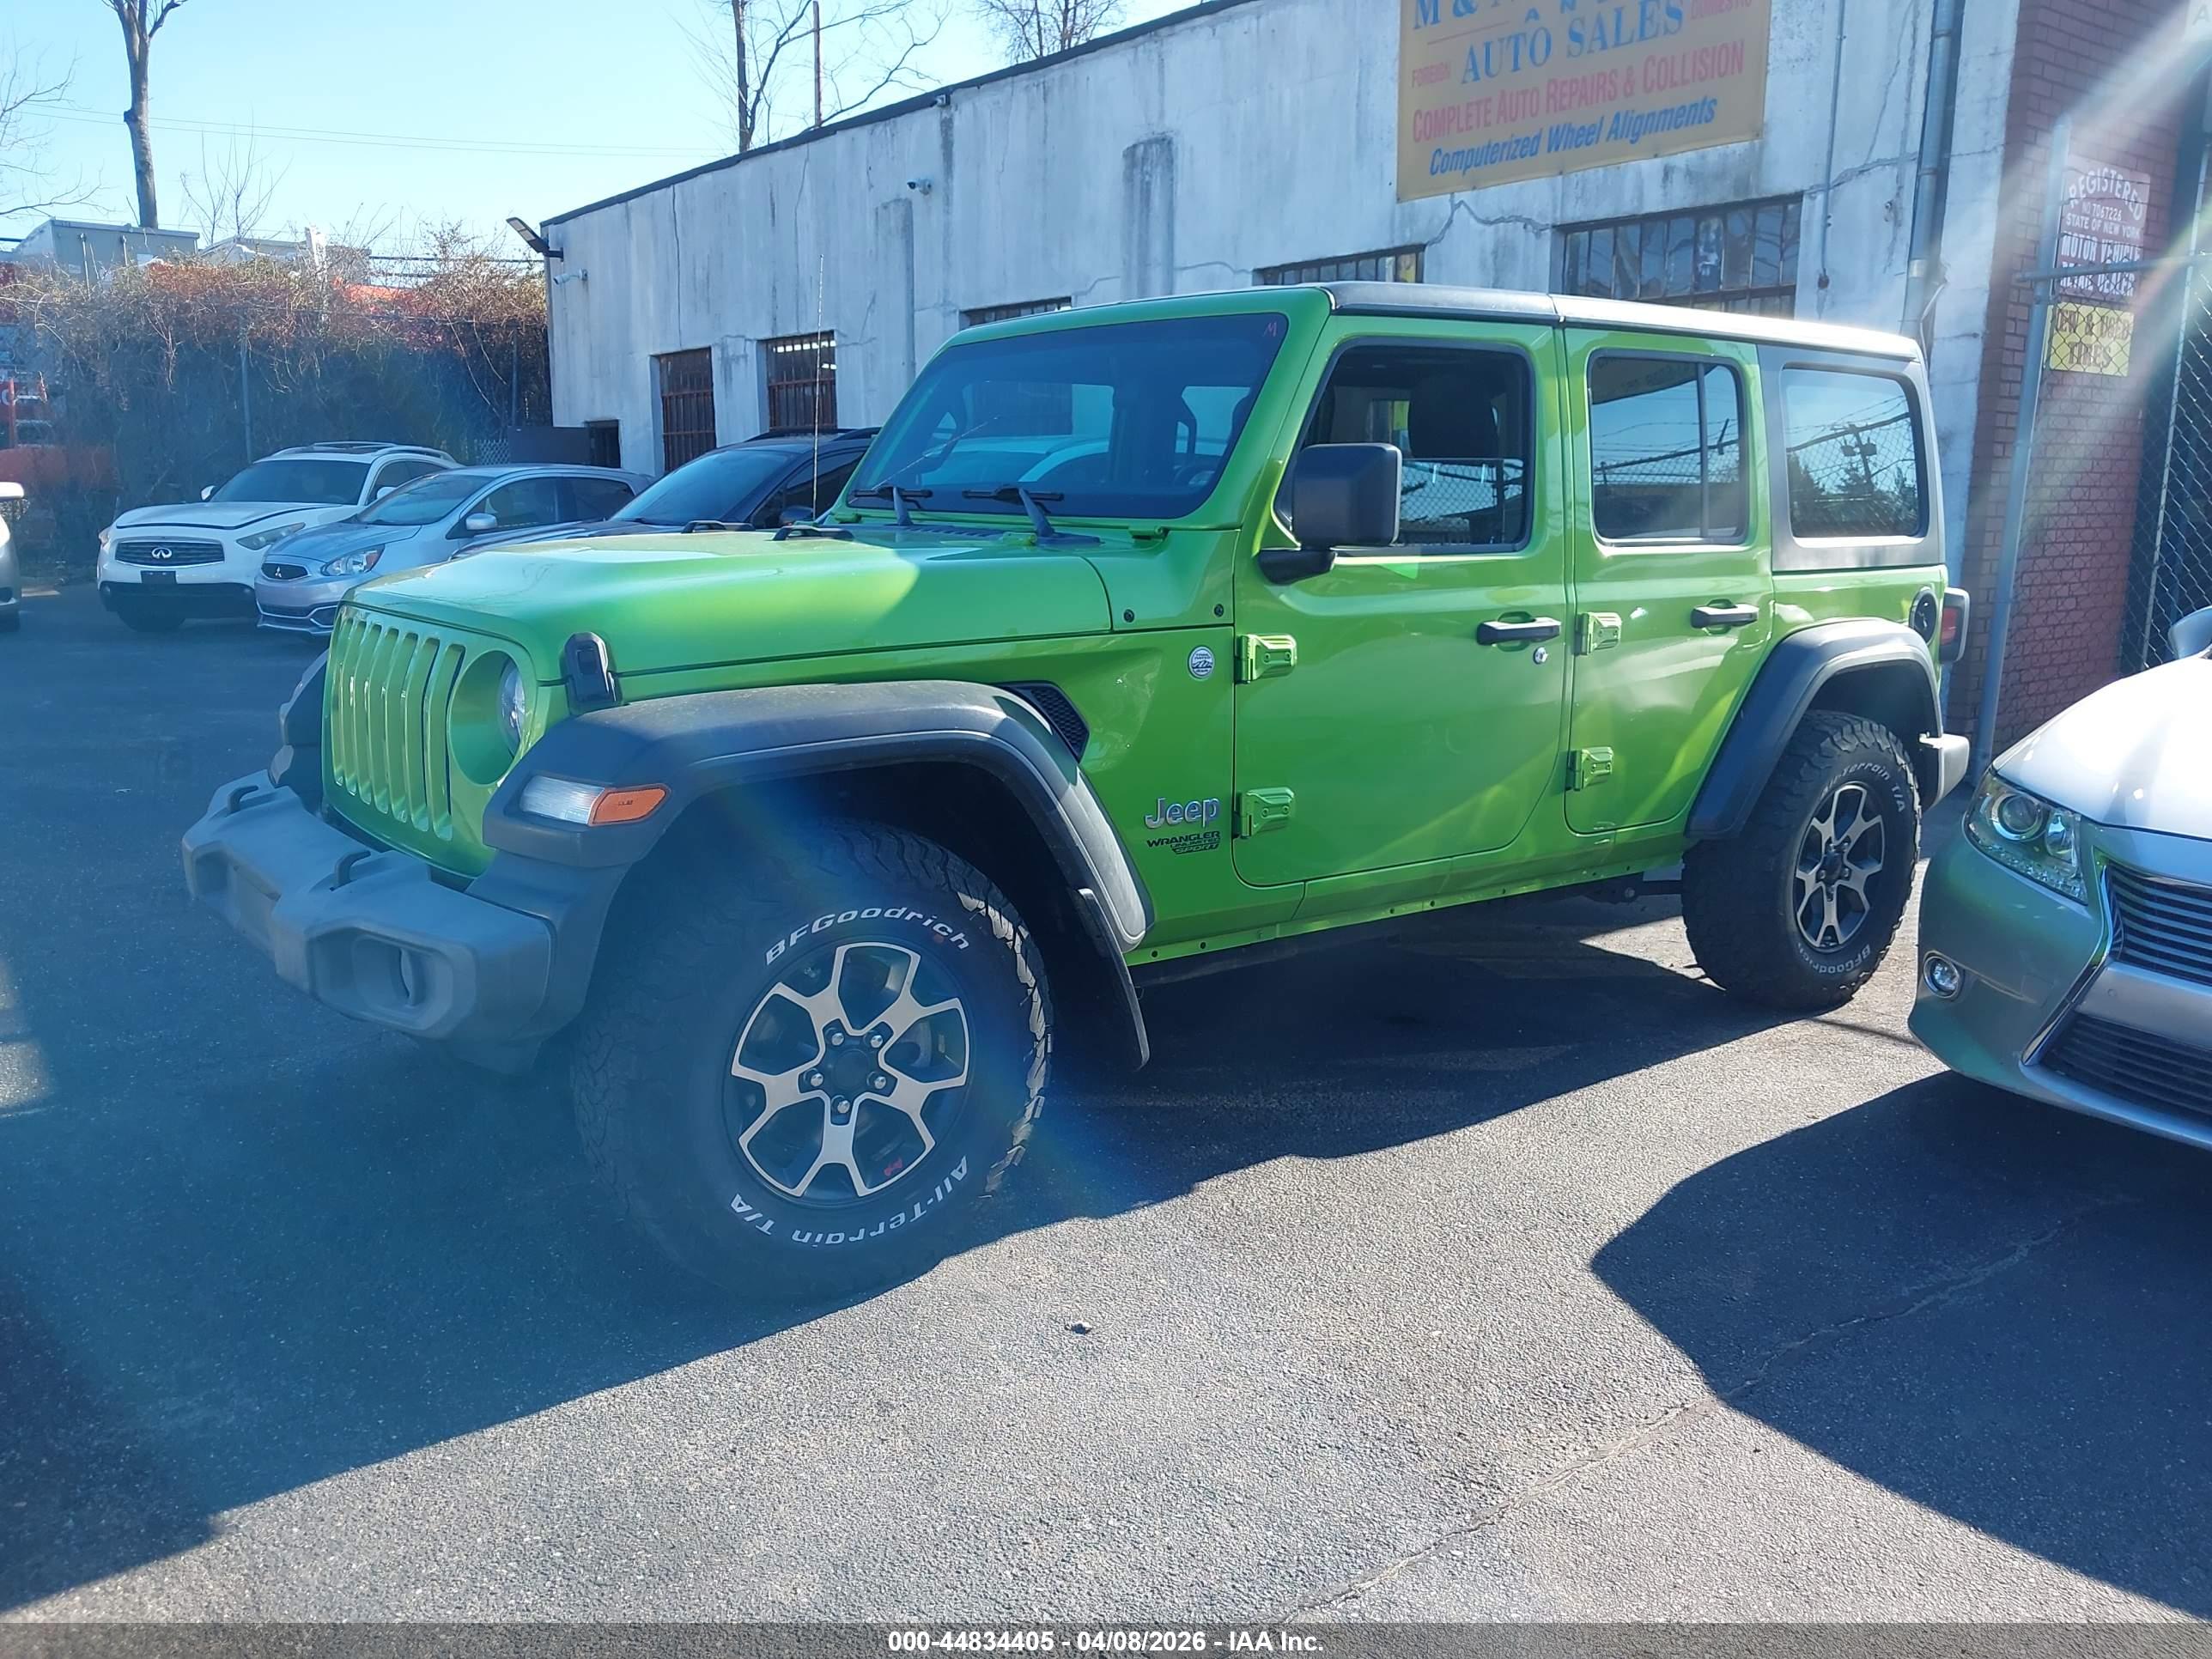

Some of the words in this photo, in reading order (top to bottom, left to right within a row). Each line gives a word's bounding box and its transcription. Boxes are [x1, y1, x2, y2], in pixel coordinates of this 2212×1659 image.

[1461, 31, 1552, 84] AUTO
[1566, 0, 1684, 58] SALES
[1413, 96, 1492, 143] COMPLETE
[1496, 88, 1540, 125] AUTO
[1546, 68, 1619, 113] REPAIRS
[1623, 65, 1635, 98] &
[1643, 40, 1745, 94] COLLISION
[1429, 127, 1543, 177] Computerized
[1547, 115, 1604, 153] Wheel
[1606, 95, 1718, 145] Alignments
[2069, 167, 2144, 221] REGISTERED
[2061, 230, 2098, 262] MOTOR
[2100, 239, 2141, 264] VEHICLE
[2066, 212, 2090, 230] STATE
[2091, 218, 2103, 232] OF
[2102, 221, 2121, 235] NEW
[2122, 225, 2142, 240] YORK
[2068, 342, 2110, 368] TIRES
[1145, 797, 1220, 829] Jeep
[1146, 830, 1221, 848] WRANGLER
[765, 906, 970, 966] BFGoodrich
[730, 1193, 775, 1236] T/A
[792, 1154, 968, 1249] All-Terrain
